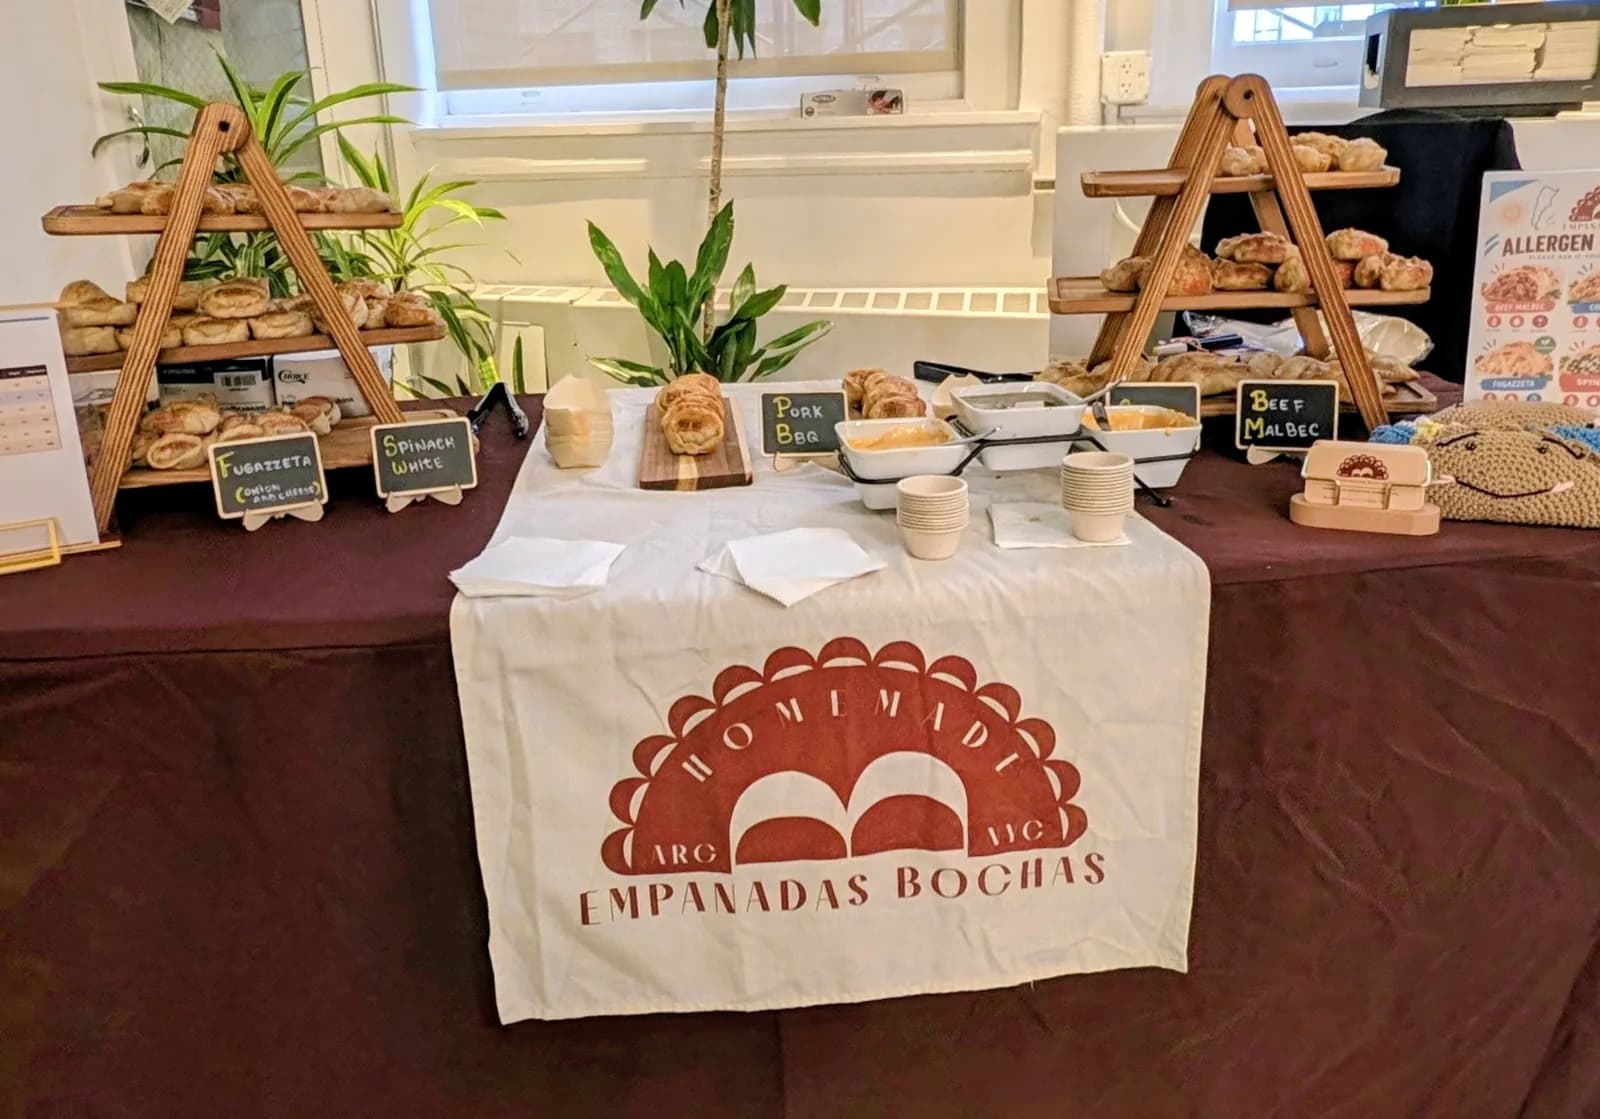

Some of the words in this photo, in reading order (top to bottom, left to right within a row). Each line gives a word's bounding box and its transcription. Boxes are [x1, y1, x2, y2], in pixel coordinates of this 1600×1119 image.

[1502, 233, 1594, 257] ALLERGEN
[773, 396, 823, 418] PORK
[1249, 390, 1304, 412] BEEF
[776, 423, 819, 444] BBQ
[1244, 417, 1319, 439] MALBEC
[216, 451, 311, 478] FUGAZZETA
[681, 689, 1022, 783] HOMEMADE
[580, 874, 868, 926] EMPANADAS
[897, 852, 1105, 899] BOCHAS
